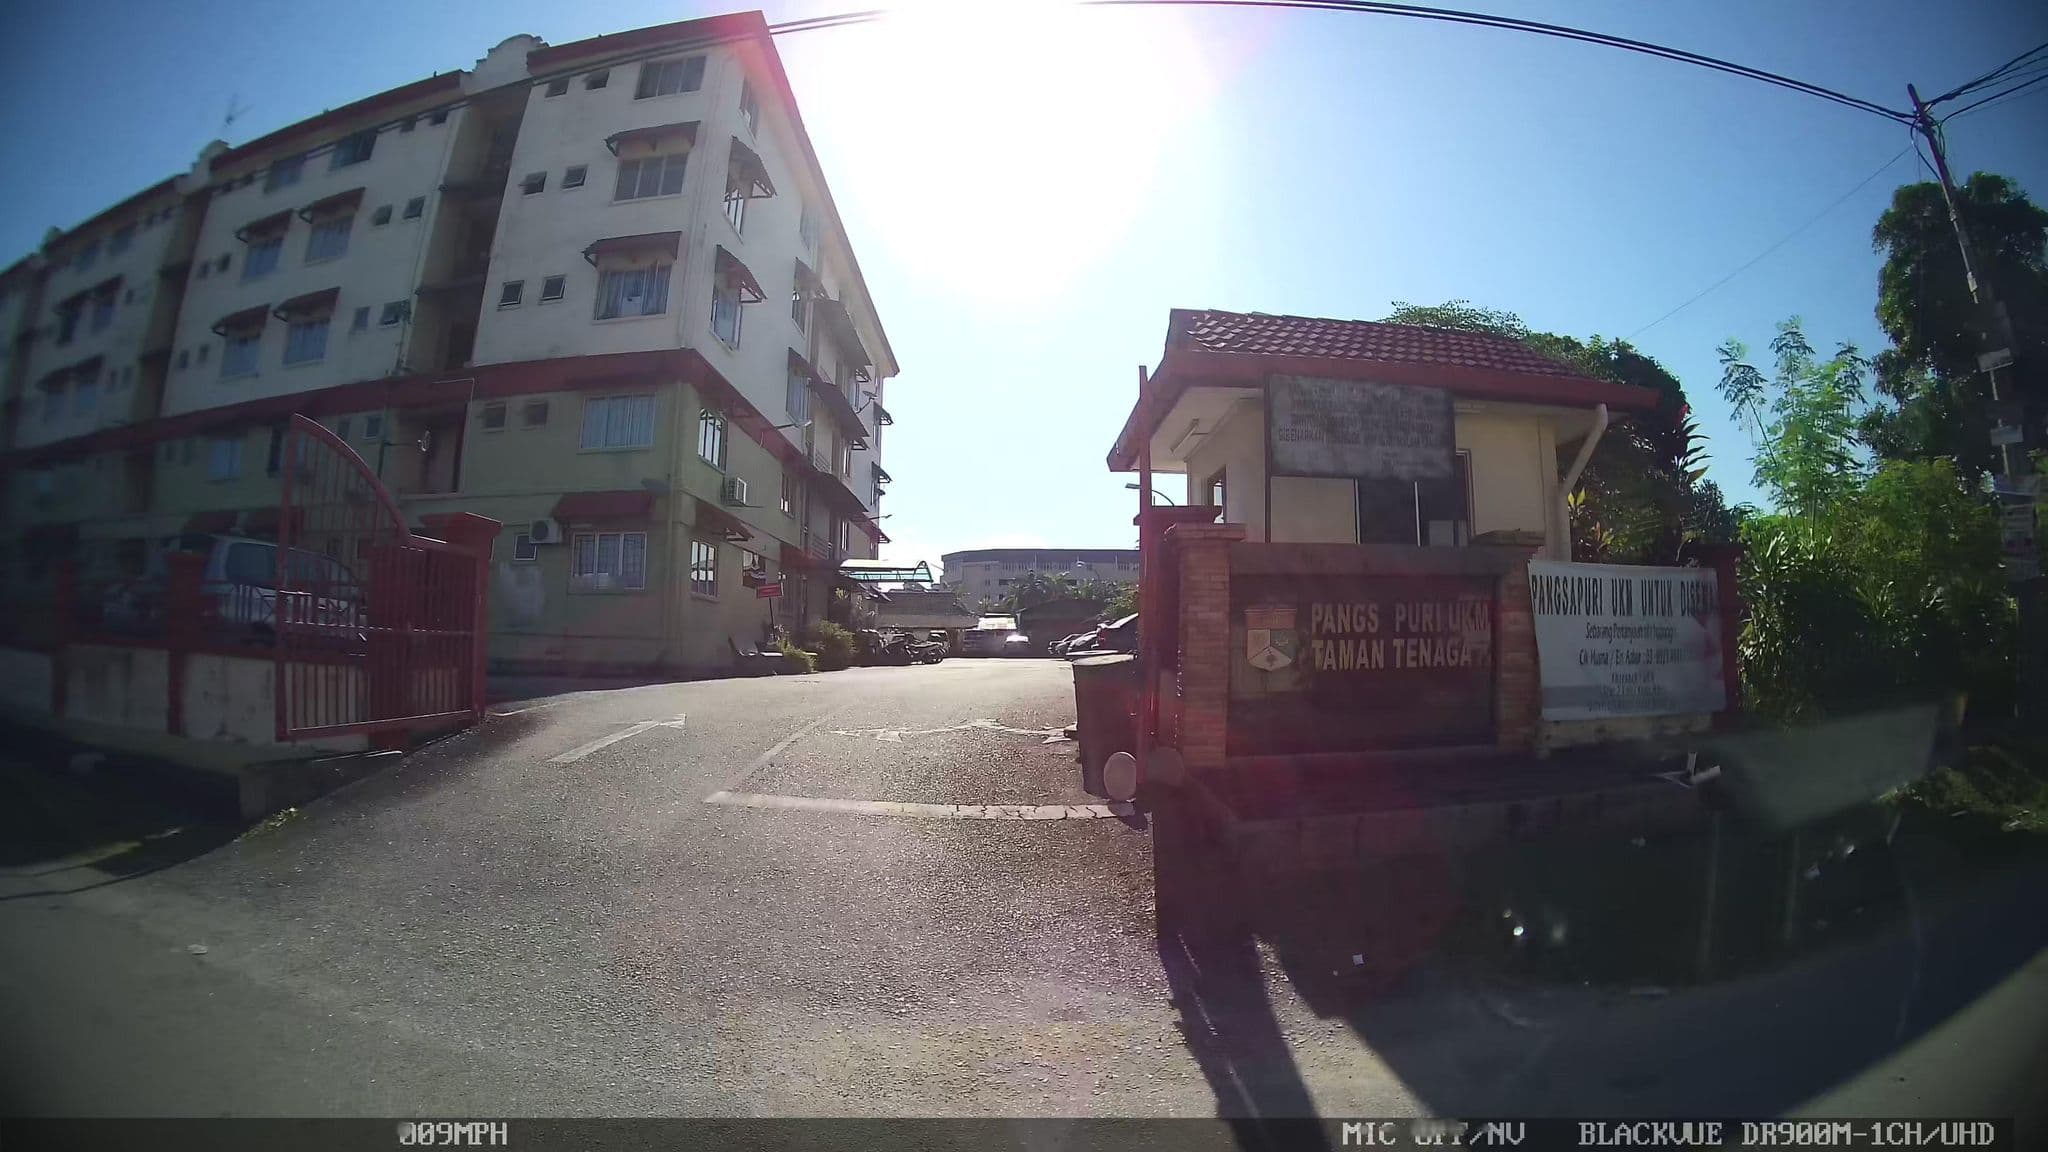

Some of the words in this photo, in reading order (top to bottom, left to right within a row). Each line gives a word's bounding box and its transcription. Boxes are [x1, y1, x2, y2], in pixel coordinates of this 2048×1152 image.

[1531, 574, 1604, 616] PANGSAPURI
[1641, 577, 1673, 617] UNTUK
[1311, 602, 1379, 634] PANGS
[1394, 602, 1442, 633] PURI
[1448, 602, 1490, 633] UKM
[1311, 639, 1385, 671] TAMAN
[1392, 637, 1473, 669] TENAGA
